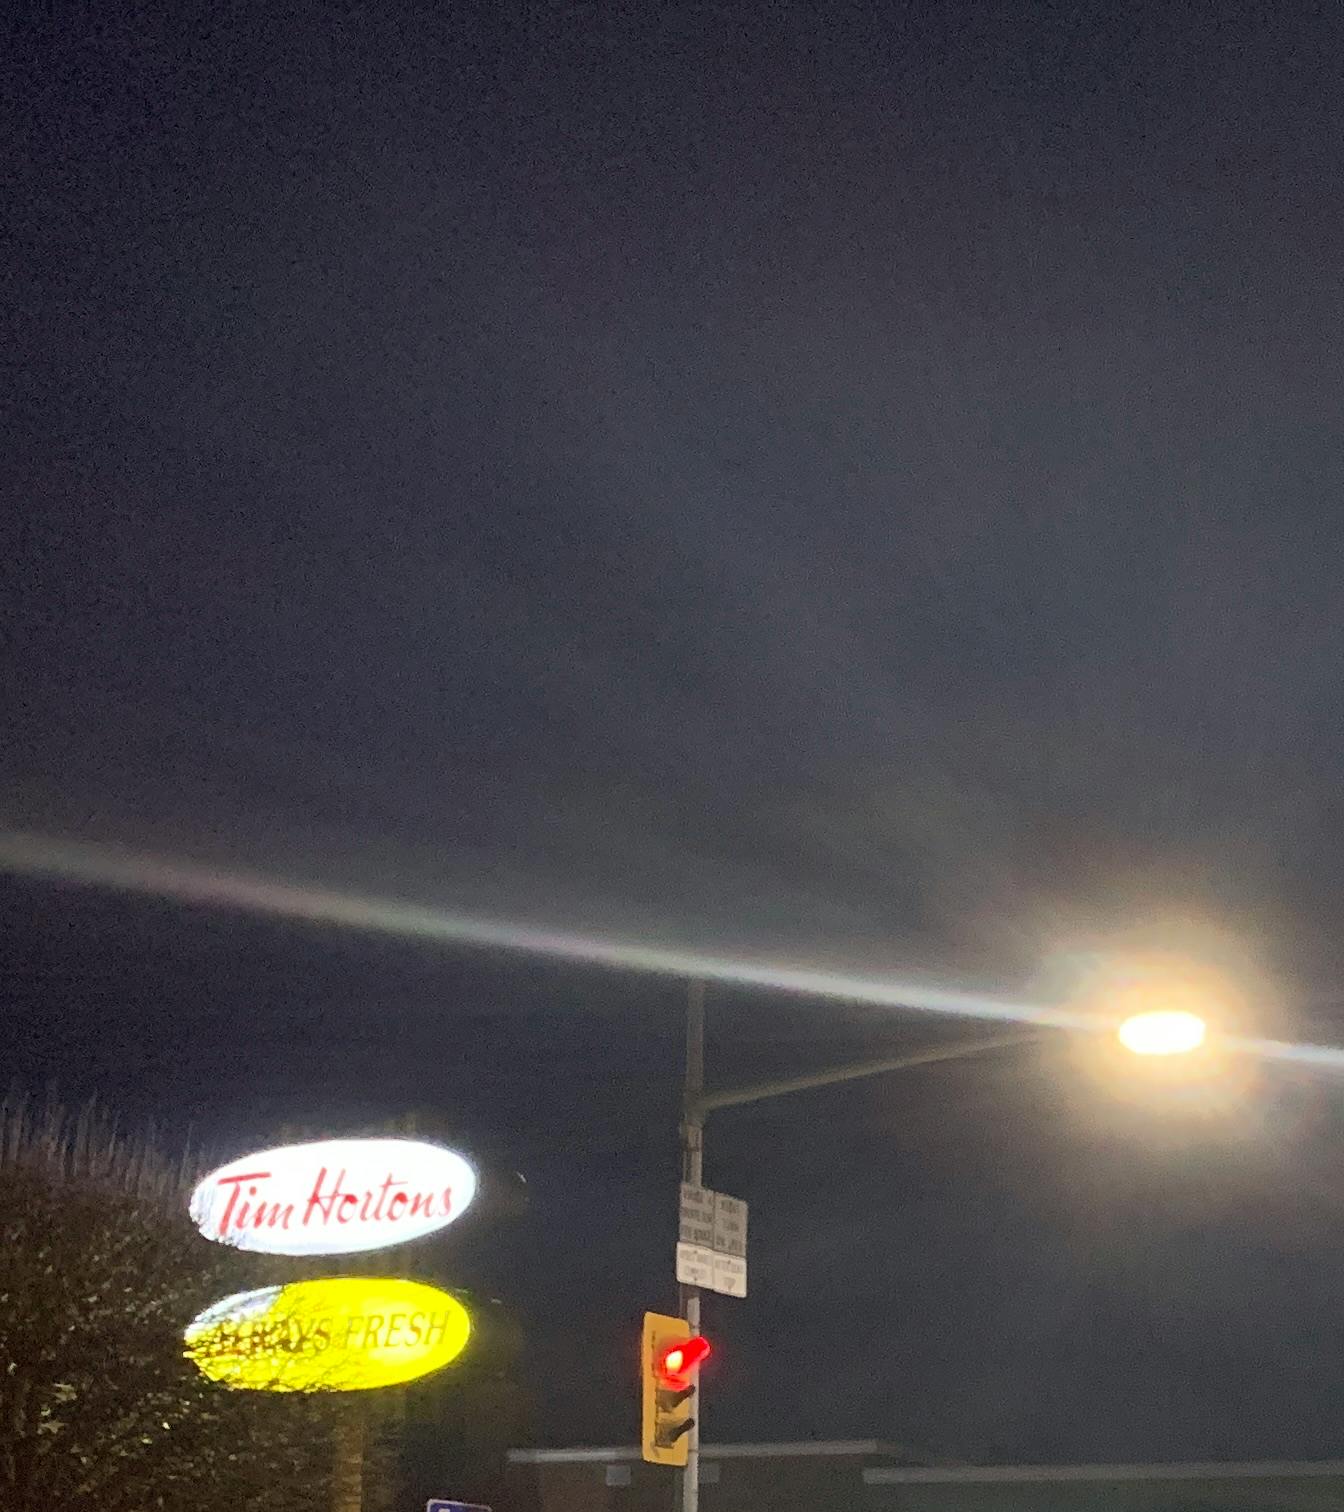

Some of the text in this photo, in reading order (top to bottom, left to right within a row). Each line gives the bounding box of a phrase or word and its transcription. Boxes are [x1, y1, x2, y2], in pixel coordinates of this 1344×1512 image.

[217, 1167, 452, 1236] Tim Hortons
[343, 1311, 449, 1350] FRESH
